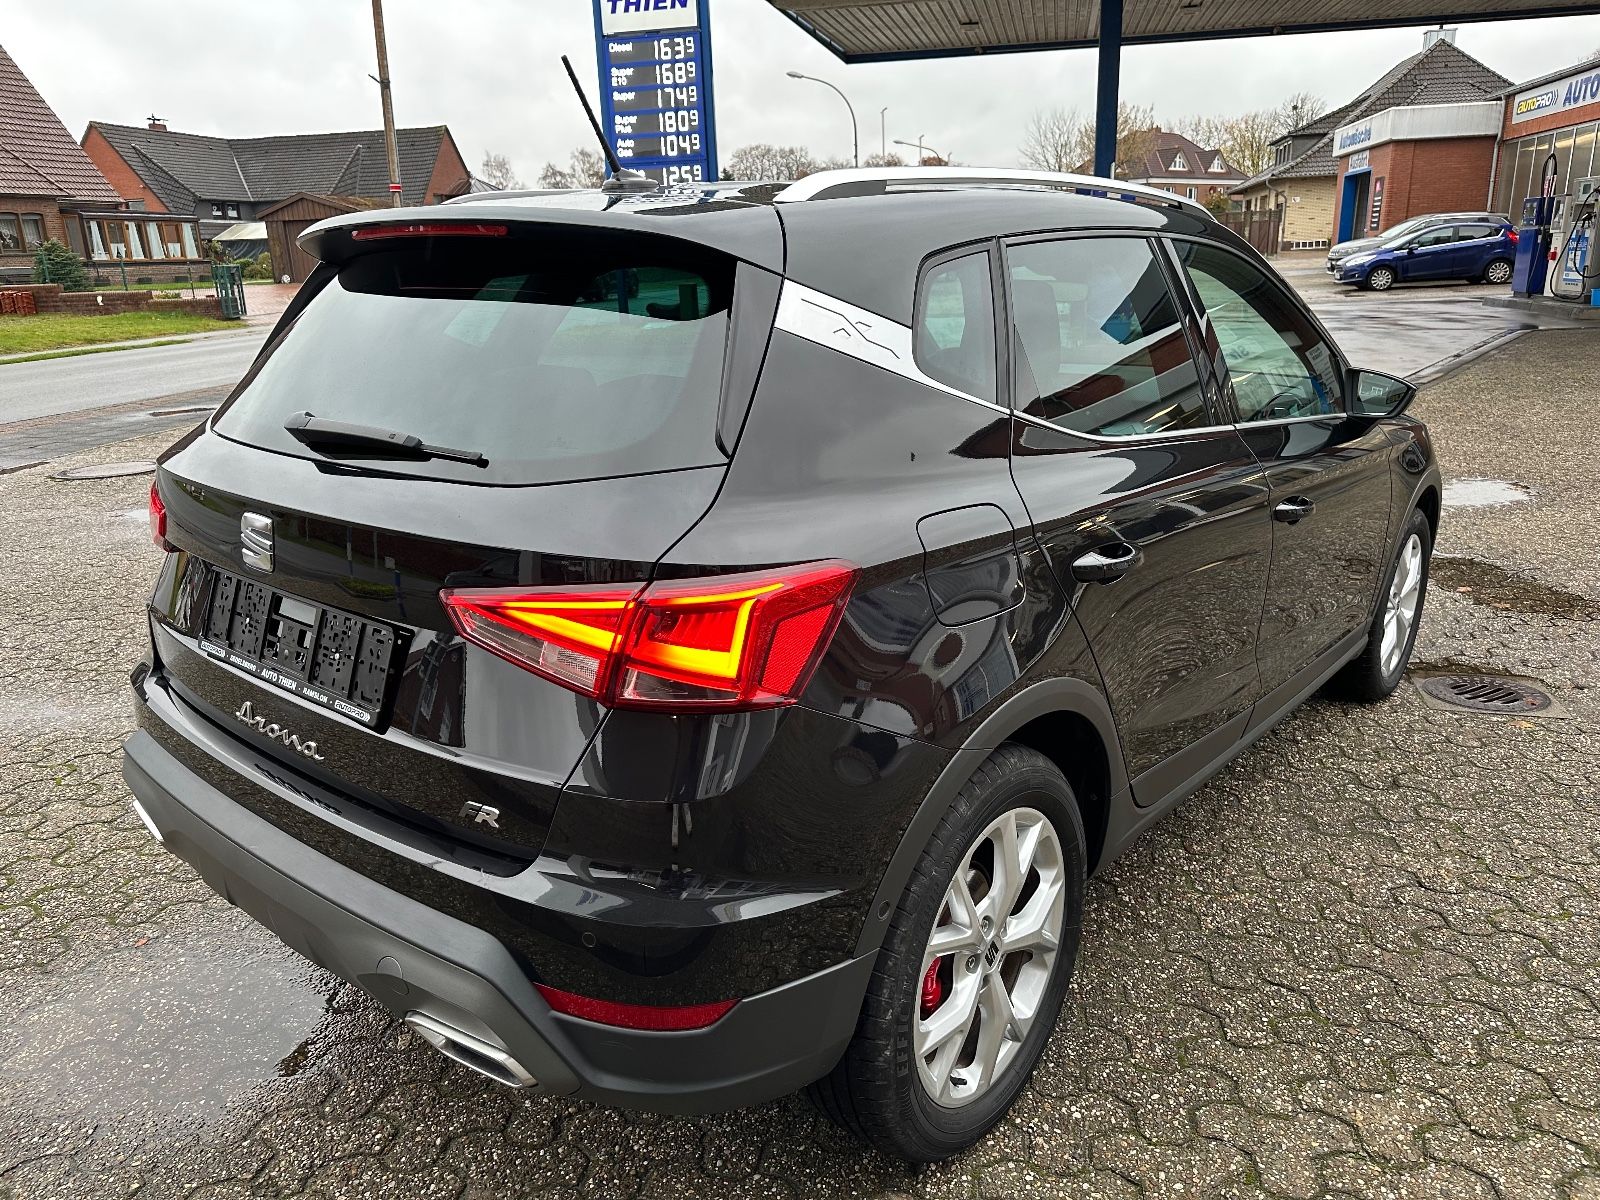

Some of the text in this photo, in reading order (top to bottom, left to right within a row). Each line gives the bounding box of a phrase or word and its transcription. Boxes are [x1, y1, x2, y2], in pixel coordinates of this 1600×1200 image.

[607, 0, 688, 14] THIEN
[609, 37, 694, 60] Diesel 1639
[611, 62, 695, 84] Super 1689
[612, 77, 627, 86] E10
[613, 86, 697, 108] Super 1749
[1563, 74, 1600, 107] AUTO
[615, 110, 698, 132] Super 1809
[615, 125, 632, 134] Plus
[617, 134, 700, 156] Auto 1049
[617, 148, 633, 157] Gas
[261, 668, 278, 682] AUTO
[279, 675, 297, 690] THIEN
[235, 701, 325, 760] Arona
[459, 801, 500, 828] FR
